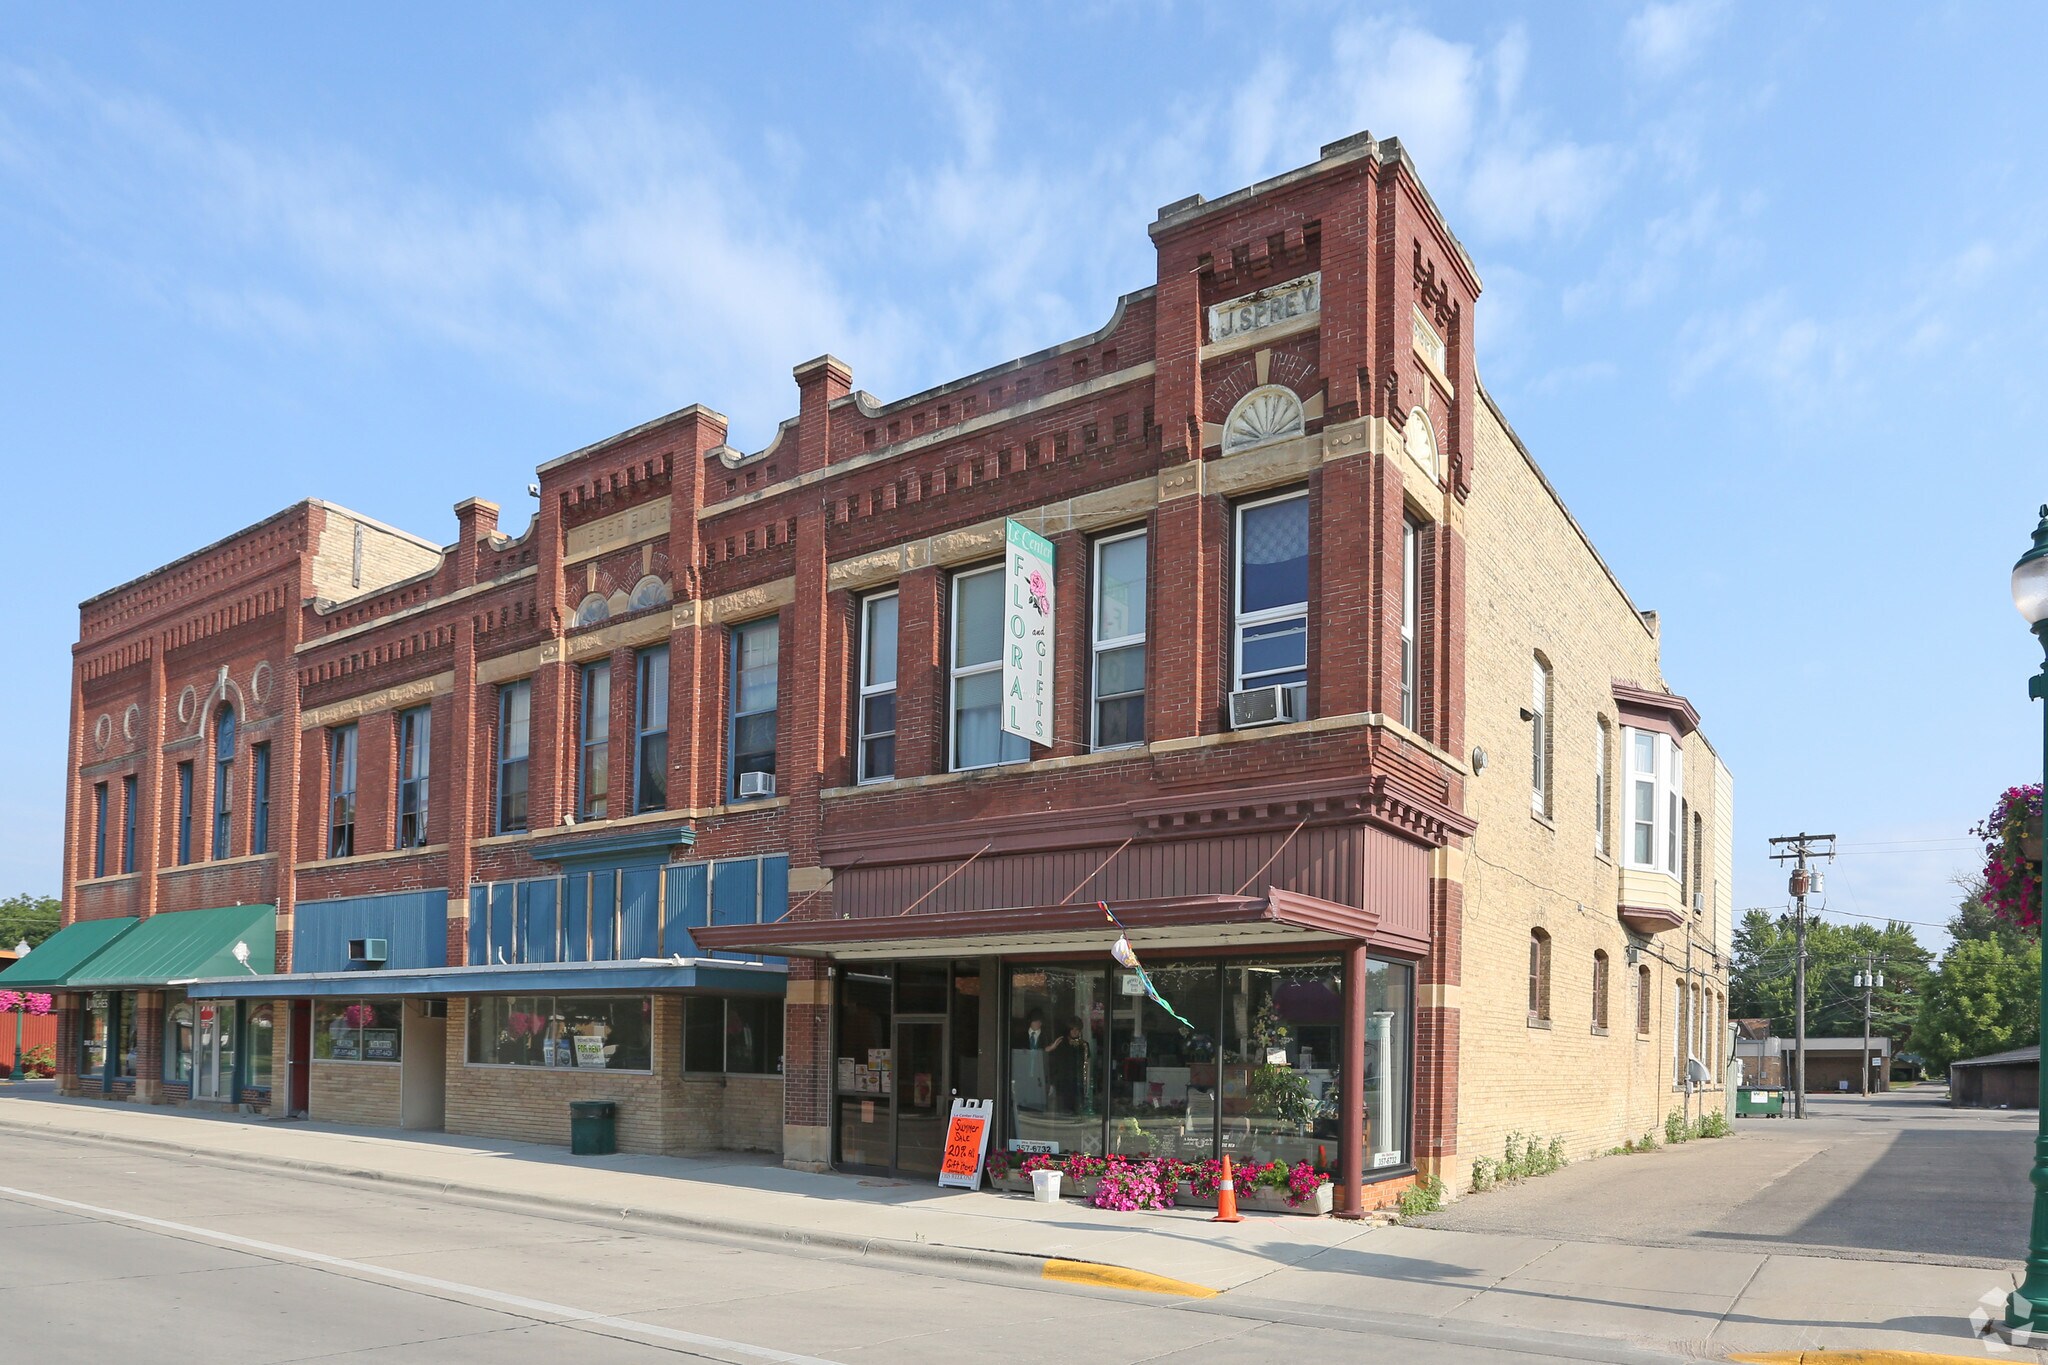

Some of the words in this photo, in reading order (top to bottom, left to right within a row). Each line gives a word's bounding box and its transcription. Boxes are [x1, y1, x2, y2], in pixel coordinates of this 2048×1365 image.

[577, 518, 623, 545] WEBER
[632, 504, 667, 529] BLOC
[1022, 530, 1051, 558] Center
[1010, 553, 1026, 730] FLORAL
[1032, 627, 1045, 636] and
[1036, 640, 1046, 737] GIFTS
[577, 1044, 587, 1053] FOR
[948, 1145, 966, 1158] 20%
[1016, 1144, 1052, 1153] 357-6732
